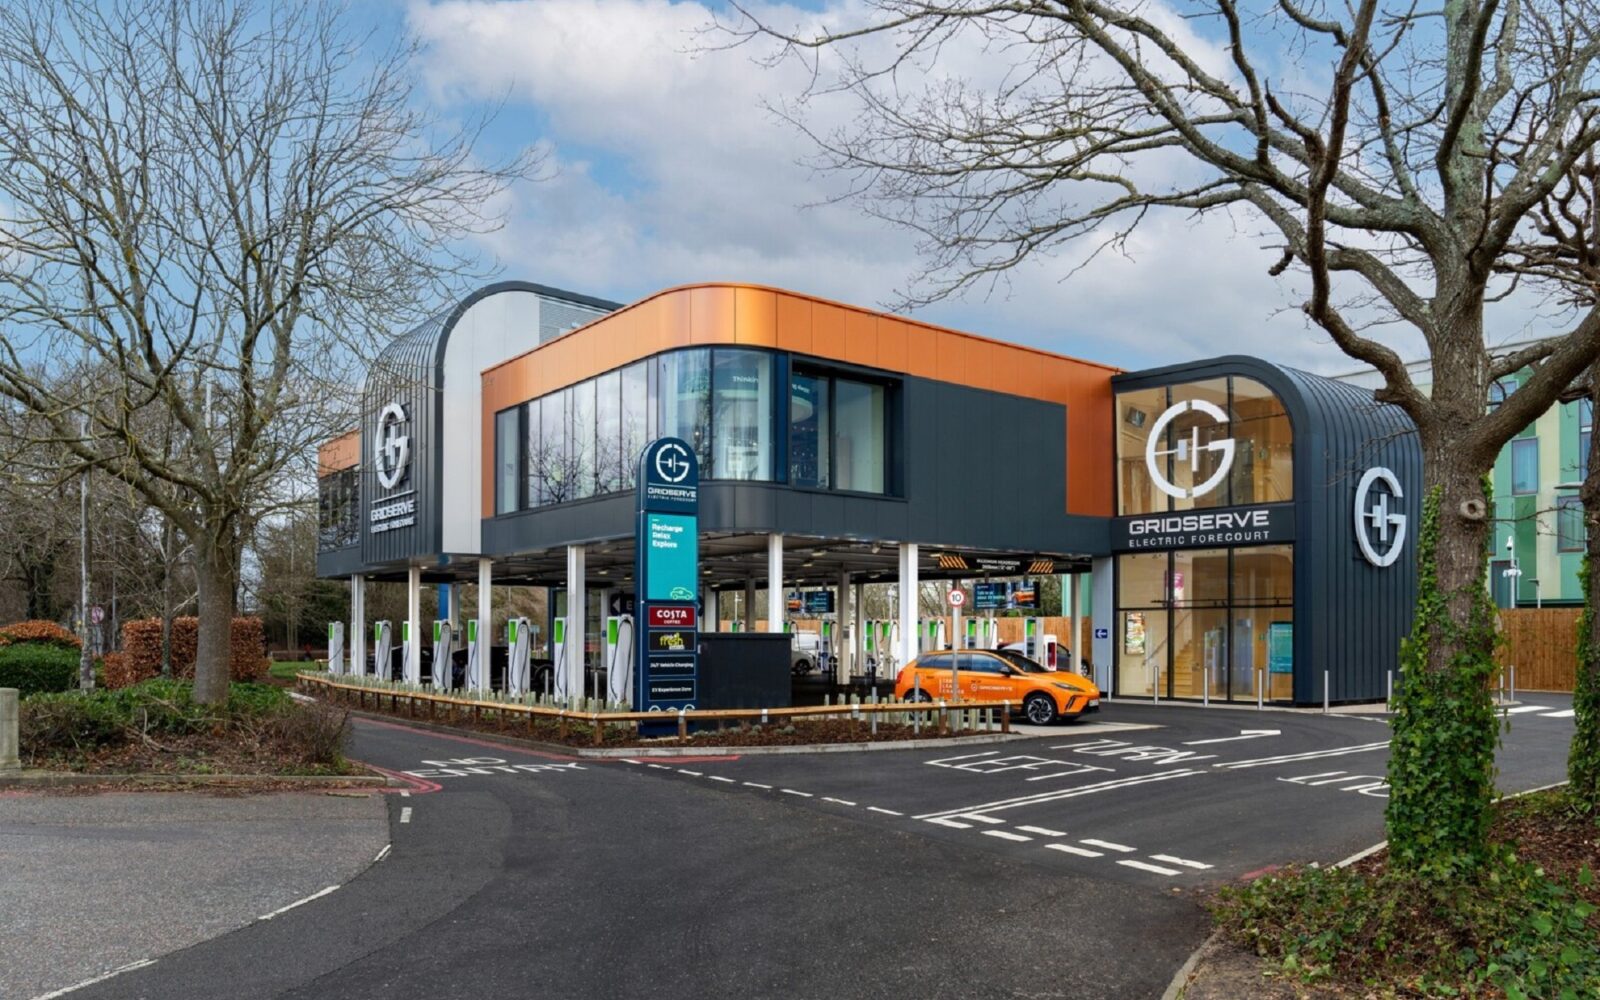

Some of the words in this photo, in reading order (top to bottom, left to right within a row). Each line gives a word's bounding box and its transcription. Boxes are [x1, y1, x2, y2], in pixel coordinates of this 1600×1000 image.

[647, 486, 697, 498] GRIDSERVE
[651, 523, 684, 533] Recharge
[1128, 510, 1270, 535] GRIDSERVE
[652, 532, 671, 540] Relax
[1129, 536, 1185, 548] ELECTRIC
[1191, 531, 1270, 544] FORECOURT
[652, 539, 678, 549] Explore
[951, 593, 962, 602] 10
[656, 610, 687, 619] COSTA
[1049, 739, 1219, 765] TURN
[420, 756, 507, 767] NO
[923, 750, 1116, 781] LEFT
[400, 762, 589, 778] ENTRY
